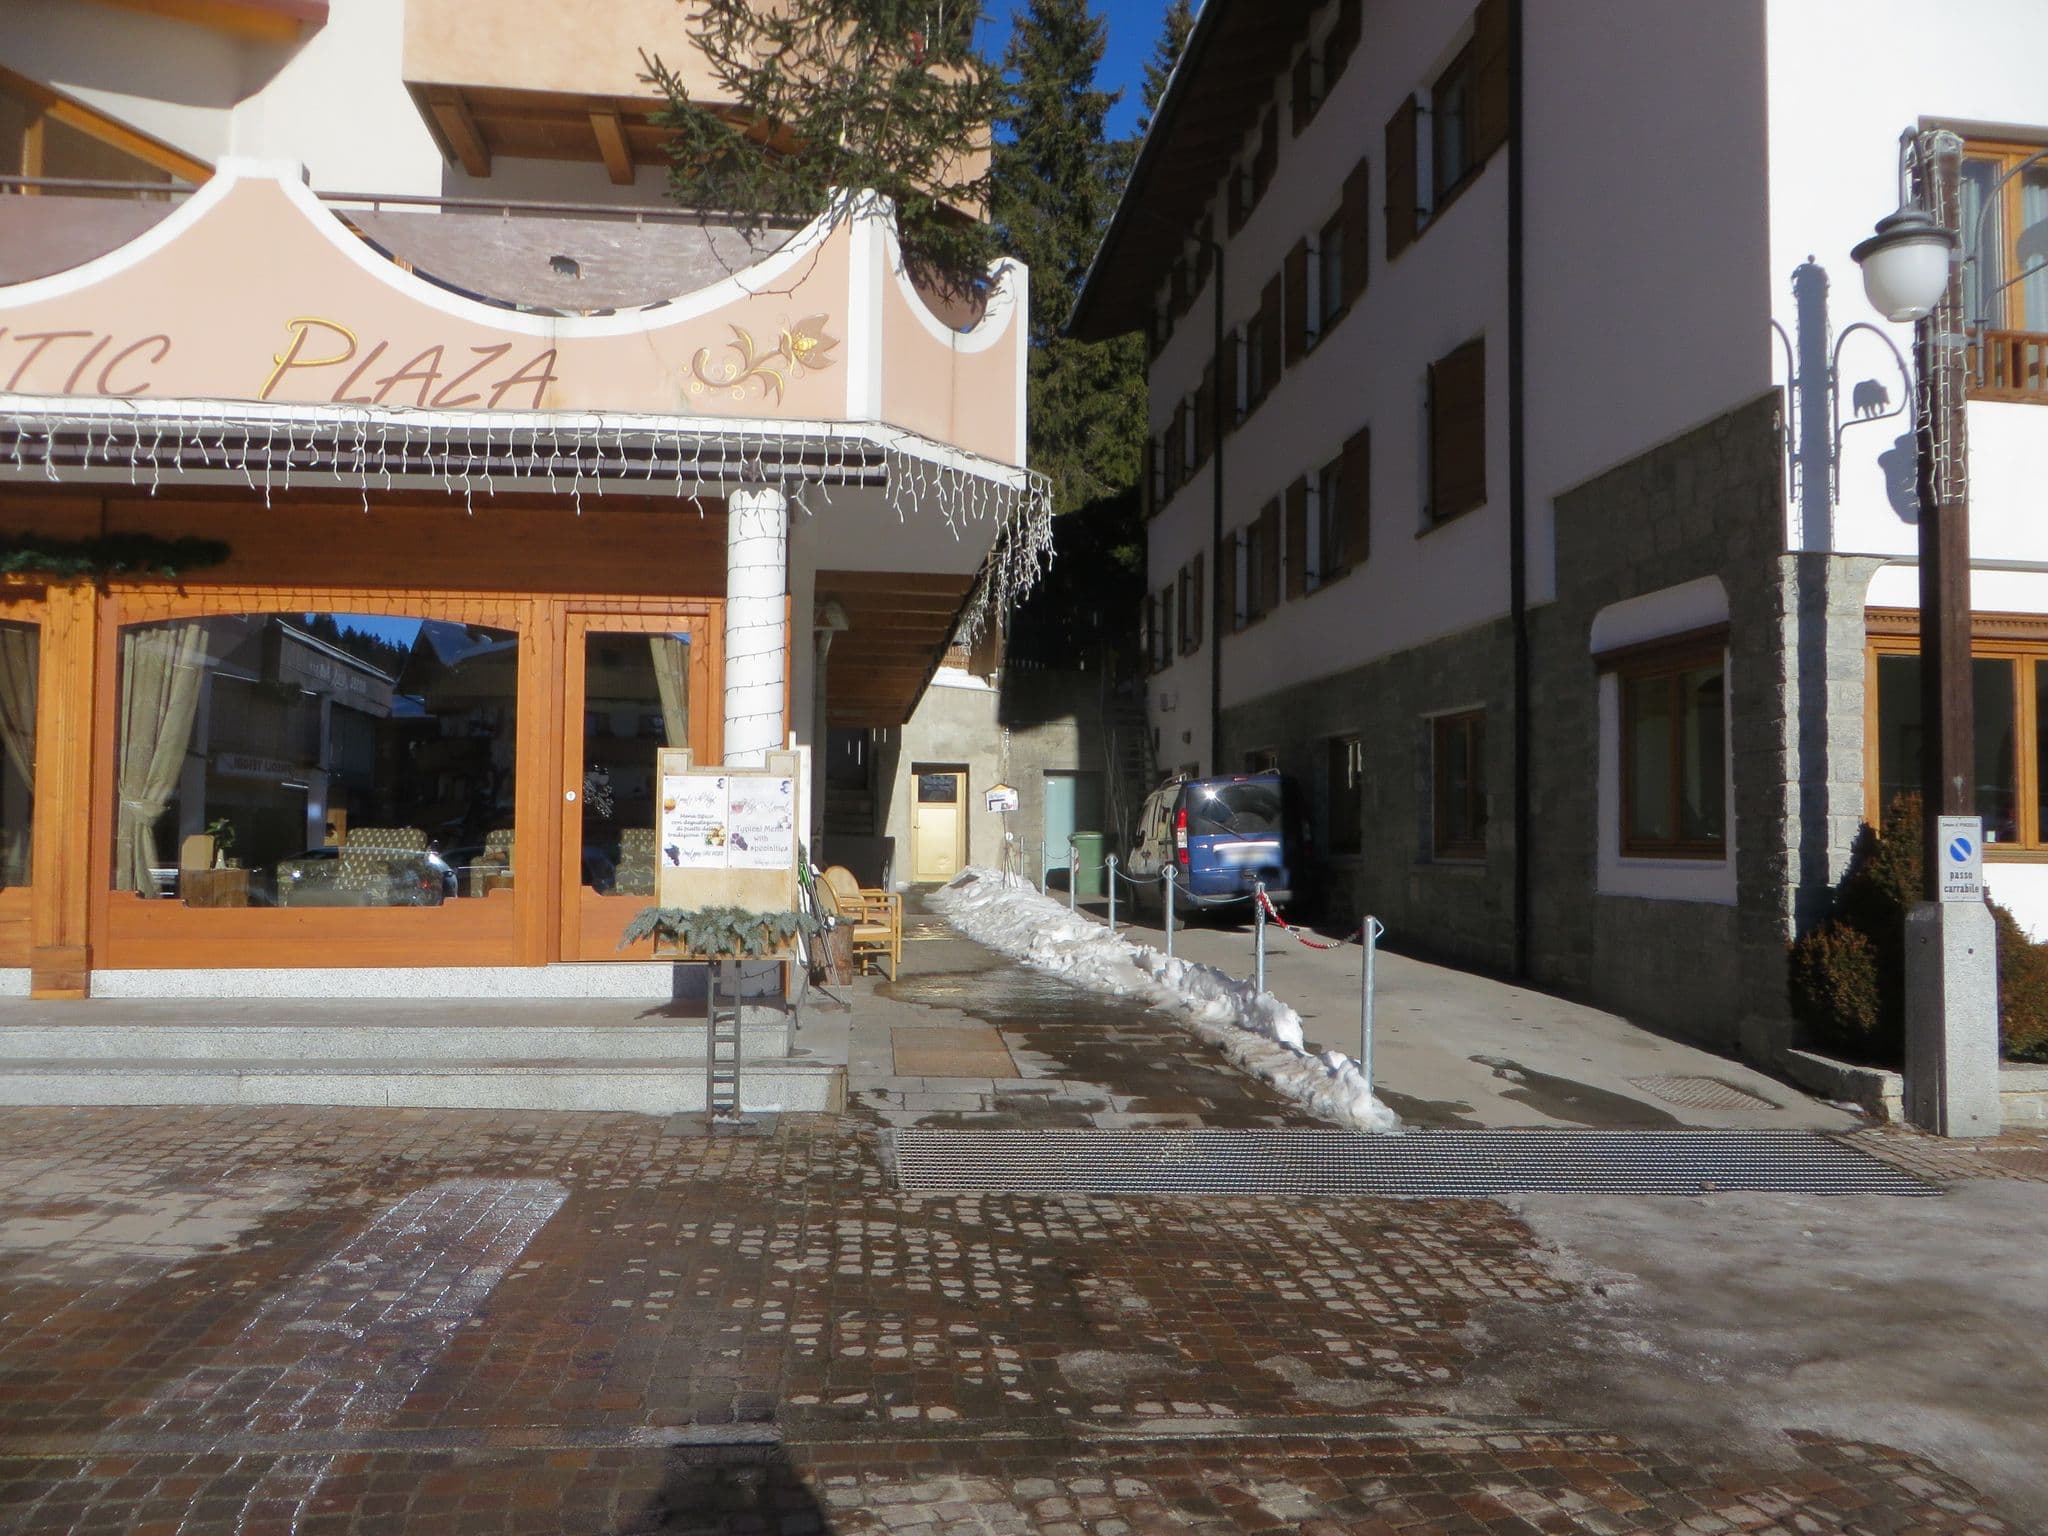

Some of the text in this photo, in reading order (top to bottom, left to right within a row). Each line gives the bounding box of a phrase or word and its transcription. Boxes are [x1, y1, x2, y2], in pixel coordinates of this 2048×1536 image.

[0, 316, 557, 410] TIC PLAZA
[1950, 871, 1973, 881] passo
[1944, 883, 1980, 893] carrabile
